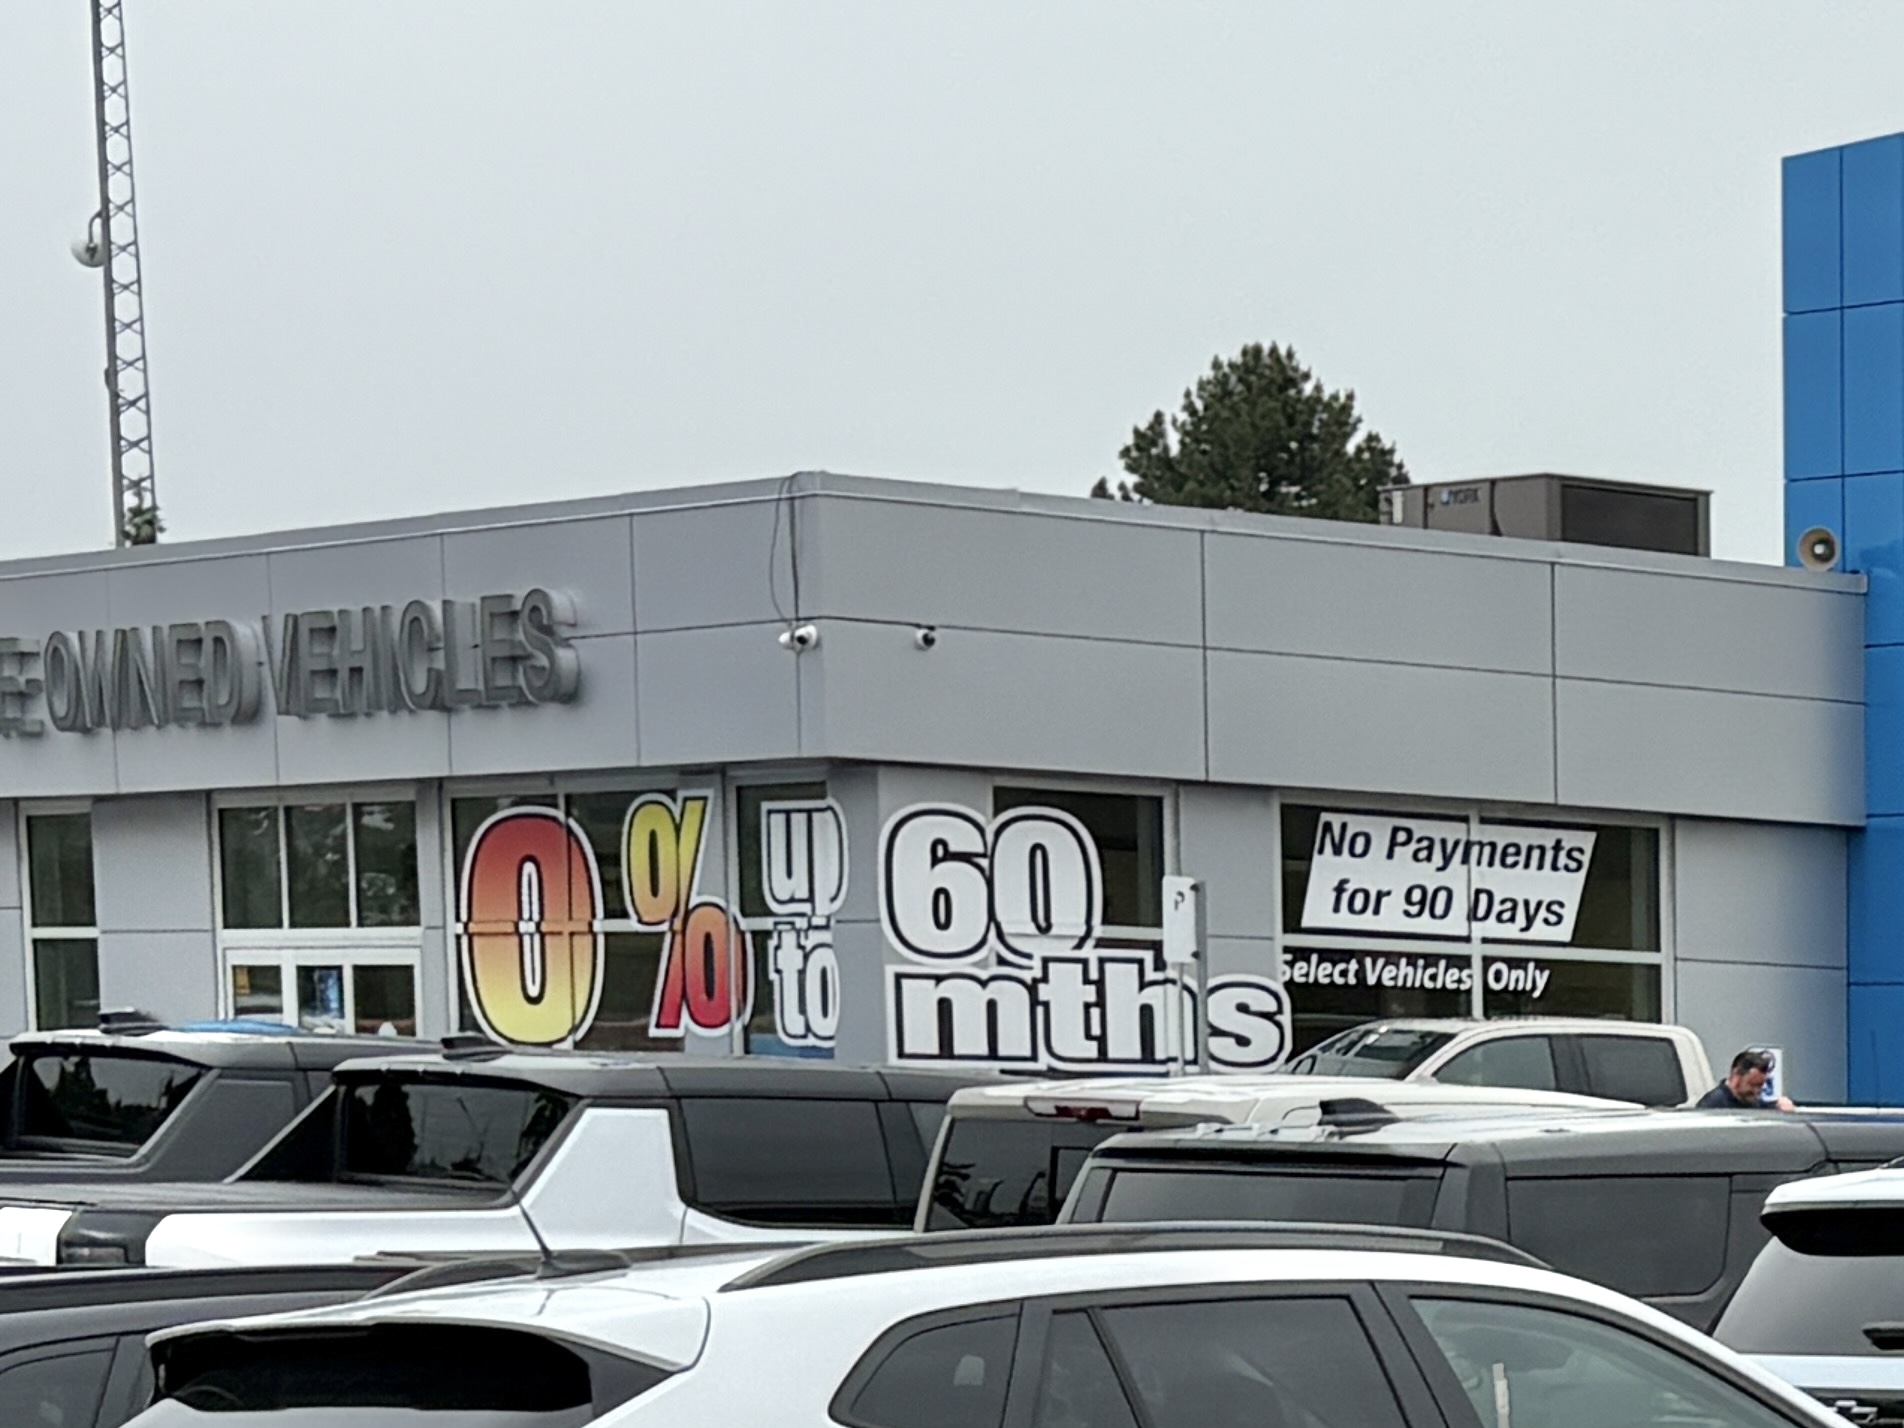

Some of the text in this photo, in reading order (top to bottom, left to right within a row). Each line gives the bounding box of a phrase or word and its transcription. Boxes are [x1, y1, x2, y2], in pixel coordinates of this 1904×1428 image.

[44, 618, 262, 733] OWNED
[261, 588, 581, 720] VEHICLES
[761, 798, 850, 935] up
[879, 800, 1103, 967] 60
[1317, 820, 1586, 874] No Payments
[1332, 878, 1566, 933] for 90 Days
[457, 790, 754, 1051] 0%
[1280, 953, 1550, 998] Select Vehicles Only
[769, 922, 840, 1049] to
[884, 950, 1292, 1074] mths
